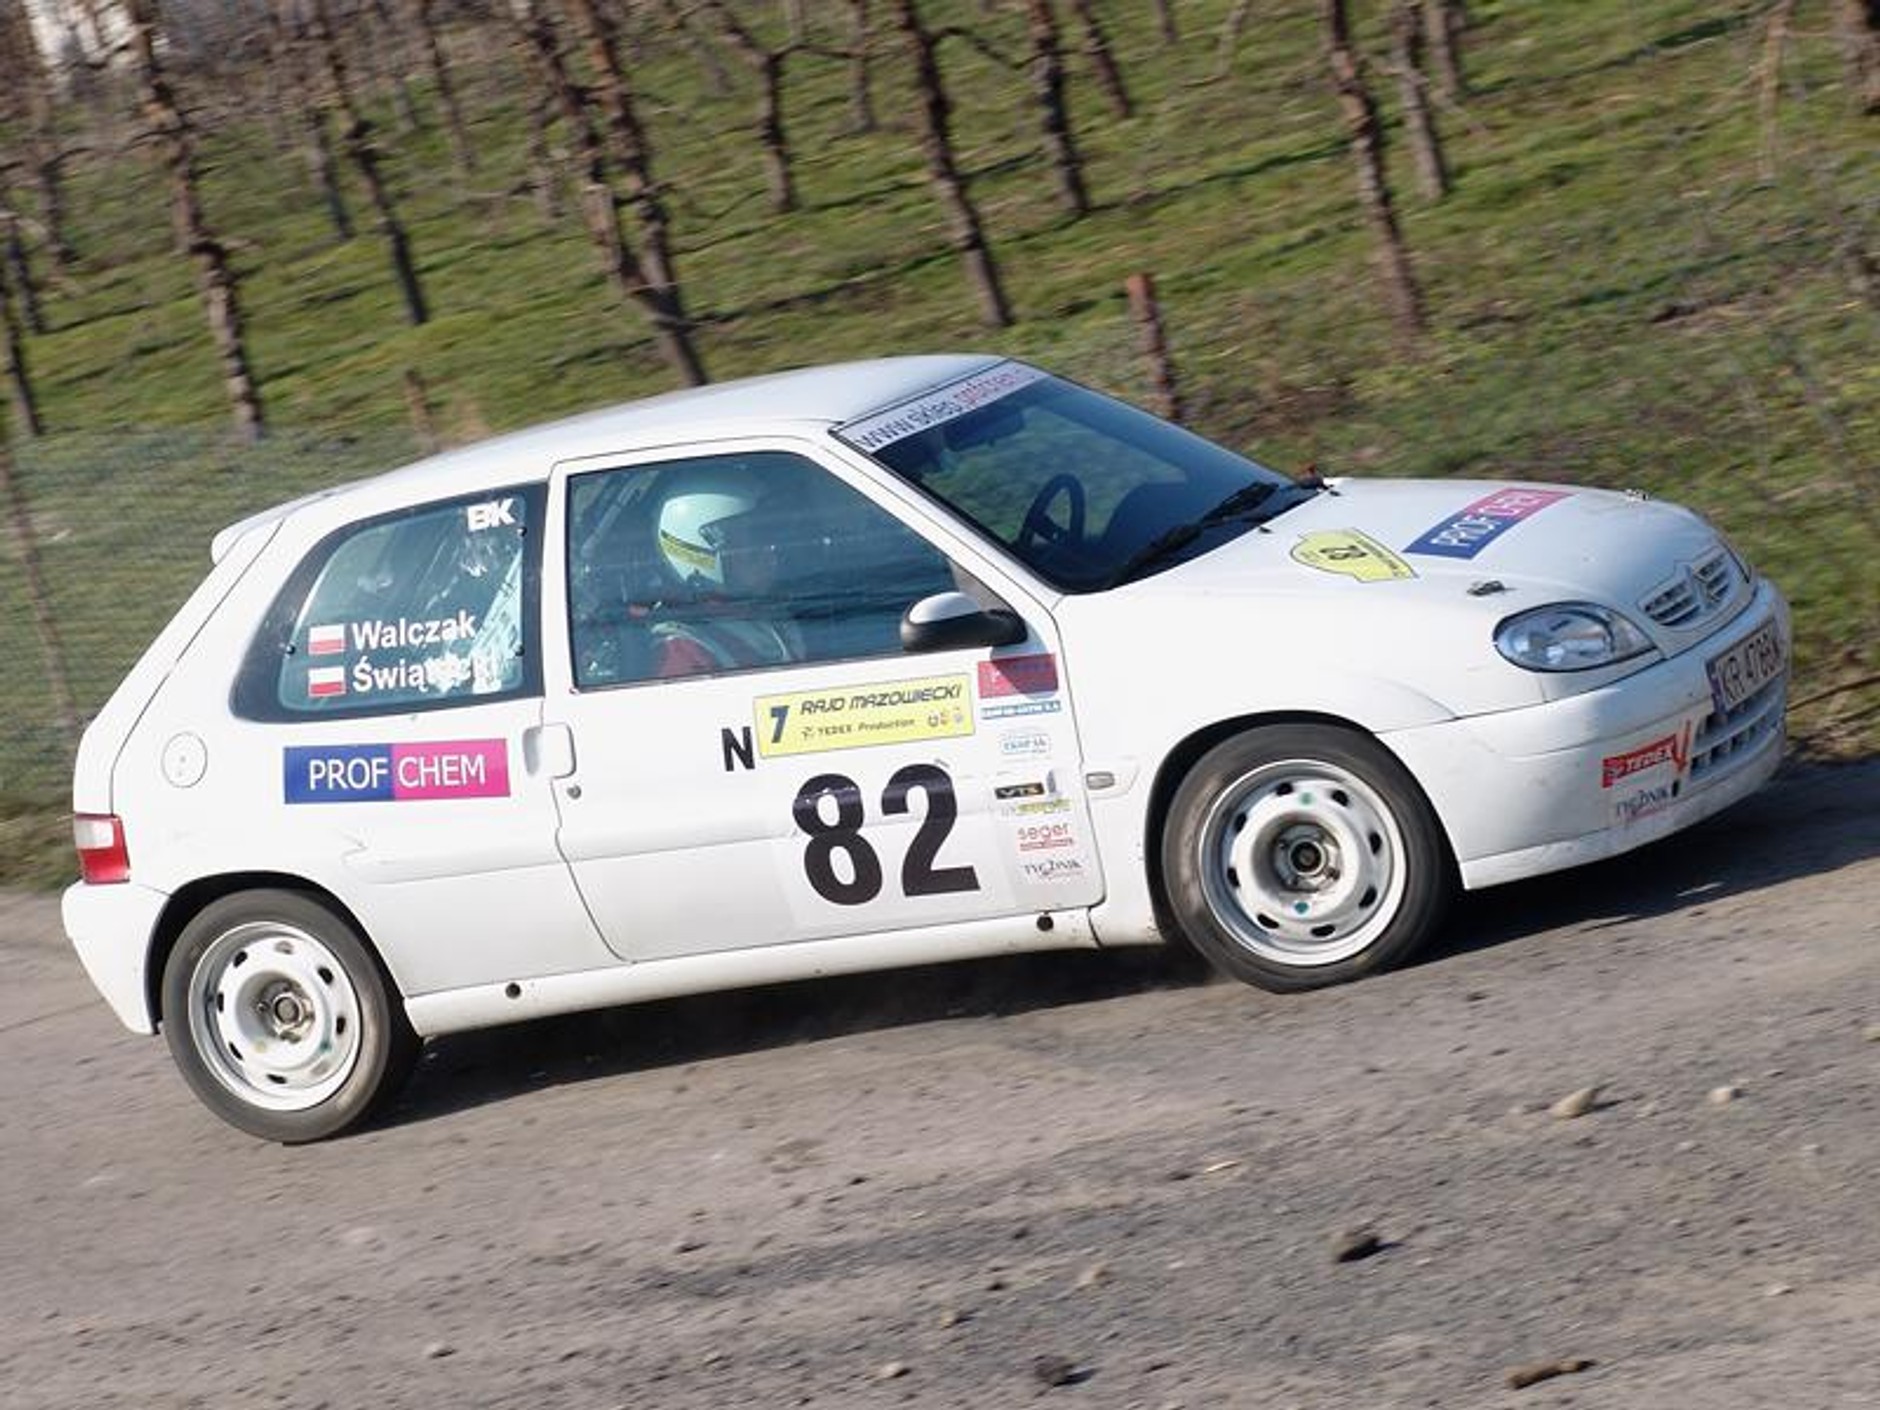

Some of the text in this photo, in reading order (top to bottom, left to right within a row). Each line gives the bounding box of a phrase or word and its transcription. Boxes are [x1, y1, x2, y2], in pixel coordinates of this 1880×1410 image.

[468, 498, 515, 532] BK
[352, 609, 477, 650] Walczak
[770, 705, 790, 744] 7
[849, 684, 962, 711] MAZOWIECKI
[858, 718, 915, 731] Production
[721, 726, 755, 772] N
[309, 754, 487, 791] PROF CHEM
[792, 763, 980, 906] 82
